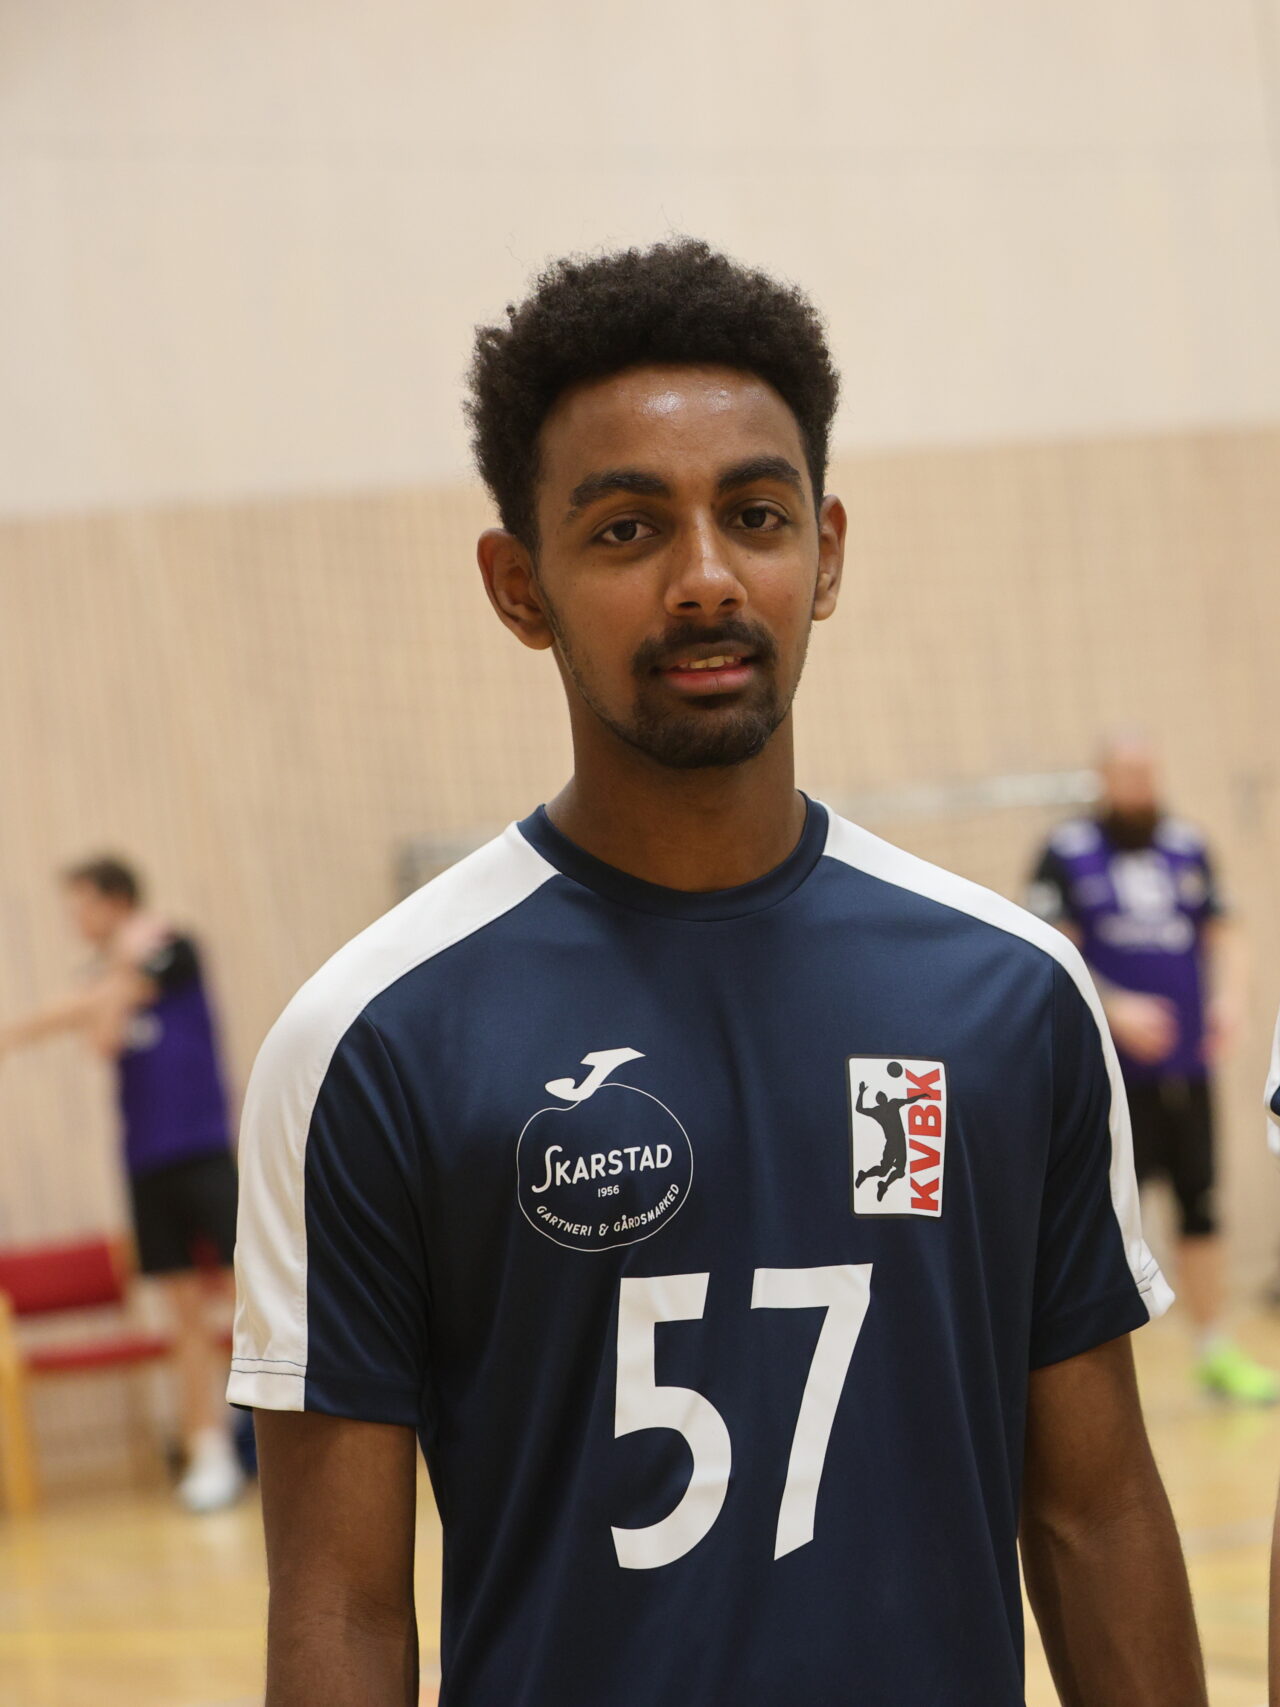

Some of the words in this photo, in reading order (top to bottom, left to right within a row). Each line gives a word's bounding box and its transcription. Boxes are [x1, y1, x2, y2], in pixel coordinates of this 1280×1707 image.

[905, 1068, 942, 1212] KVBK
[531, 1143, 673, 1193] SKARSTAD
[597, 1184, 620, 1198] 1956
[536, 1204, 592, 1237] GARTNERI
[598, 1223, 609, 1236] &
[613, 1183, 680, 1233] GÅRDSMARKED
[611, 1263, 873, 1569] 57
